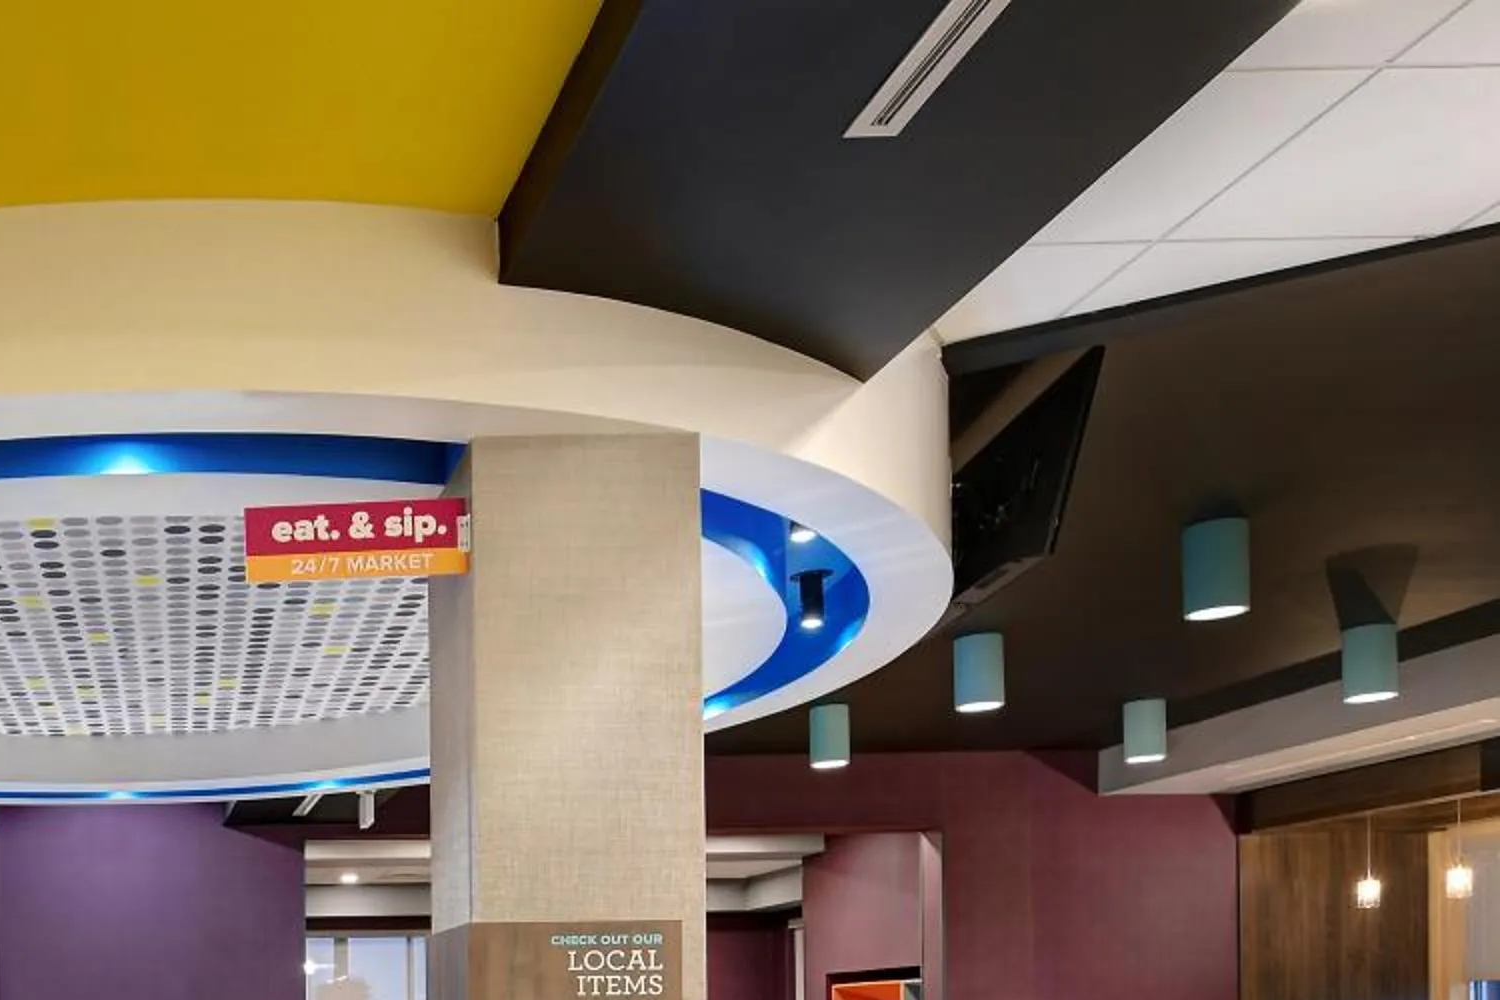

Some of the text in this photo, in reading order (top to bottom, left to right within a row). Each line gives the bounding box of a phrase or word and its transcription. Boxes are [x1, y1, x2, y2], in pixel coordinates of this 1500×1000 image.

[271, 506, 447, 543] eat. & sip.
[291, 553, 433, 575] 24/7 MARKET
[551, 933, 663, 946] CHECK OUT OUR
[568, 949, 663, 971] LOCAL
[576, 974, 663, 996] ITEMS
